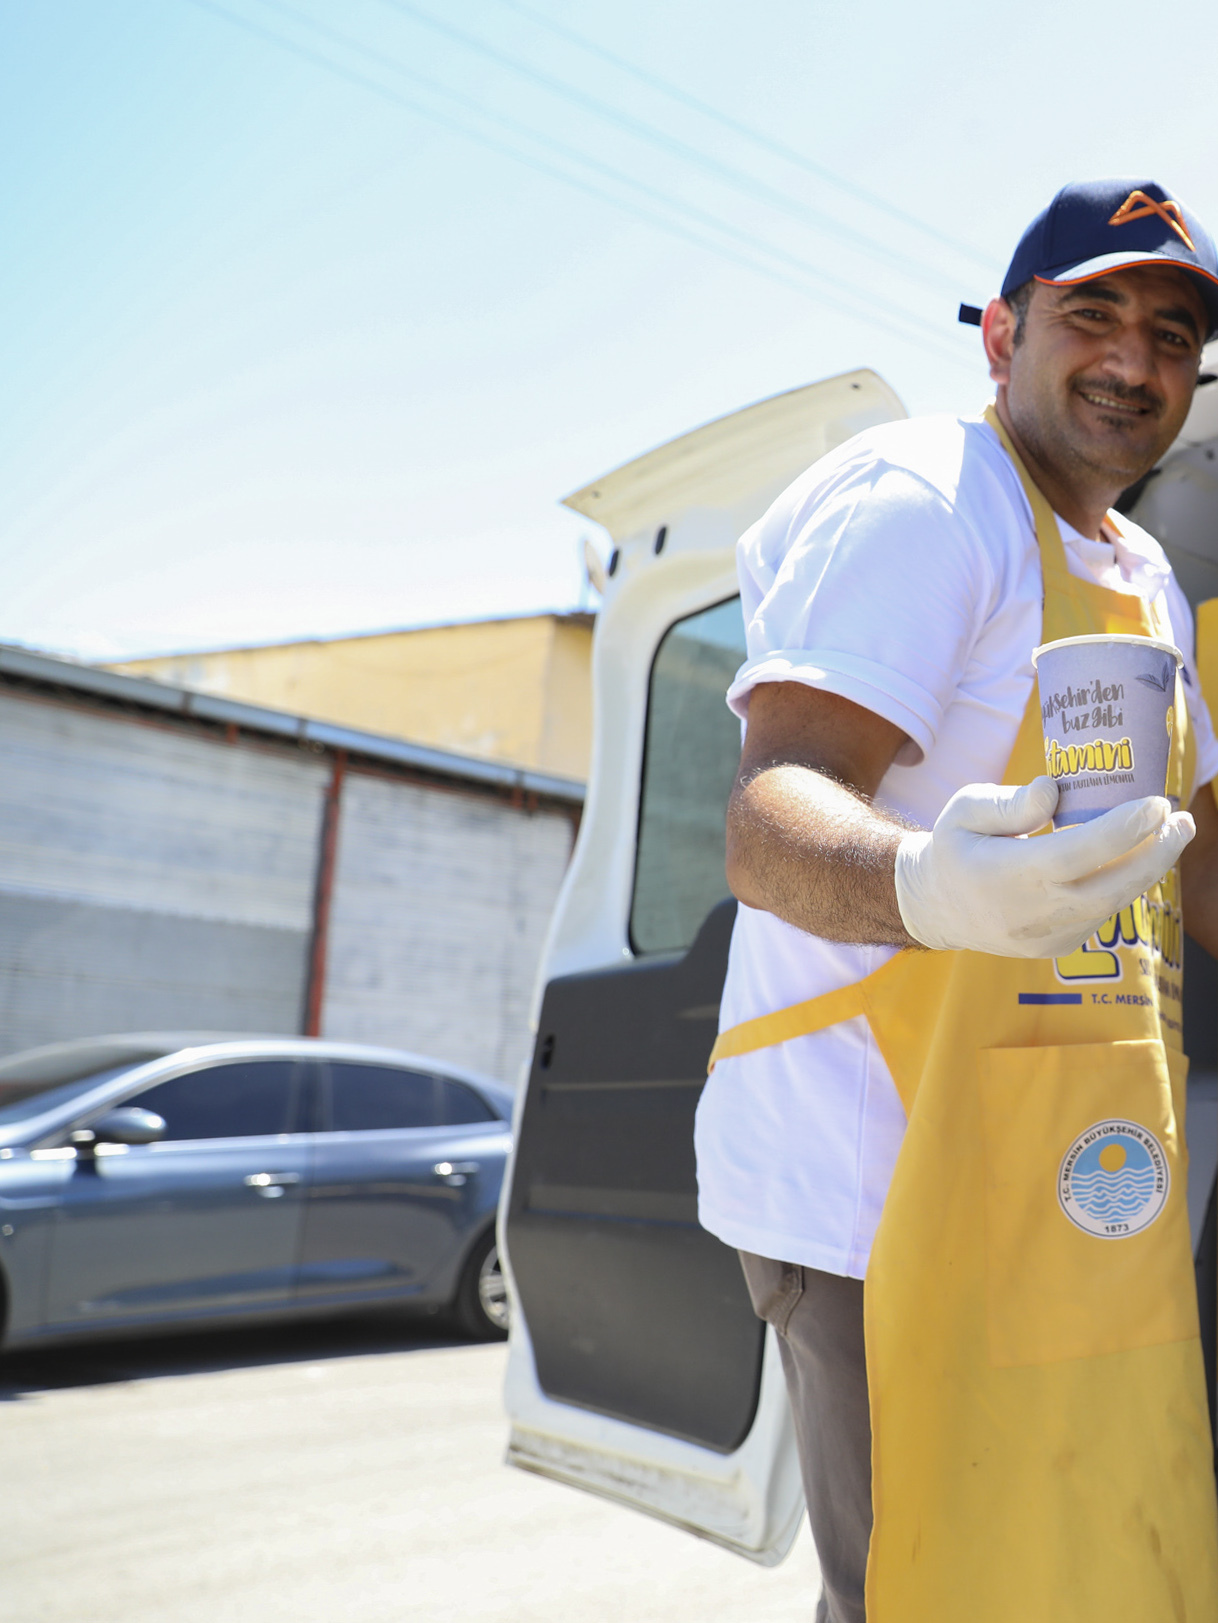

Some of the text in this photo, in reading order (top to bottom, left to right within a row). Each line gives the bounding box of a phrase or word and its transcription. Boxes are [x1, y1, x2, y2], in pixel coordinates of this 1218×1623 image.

[1062, 705, 1123, 734] buz gibi
[1091, 994, 1112, 1004] T.C.
[1104, 1223, 1130, 1233] 1873
